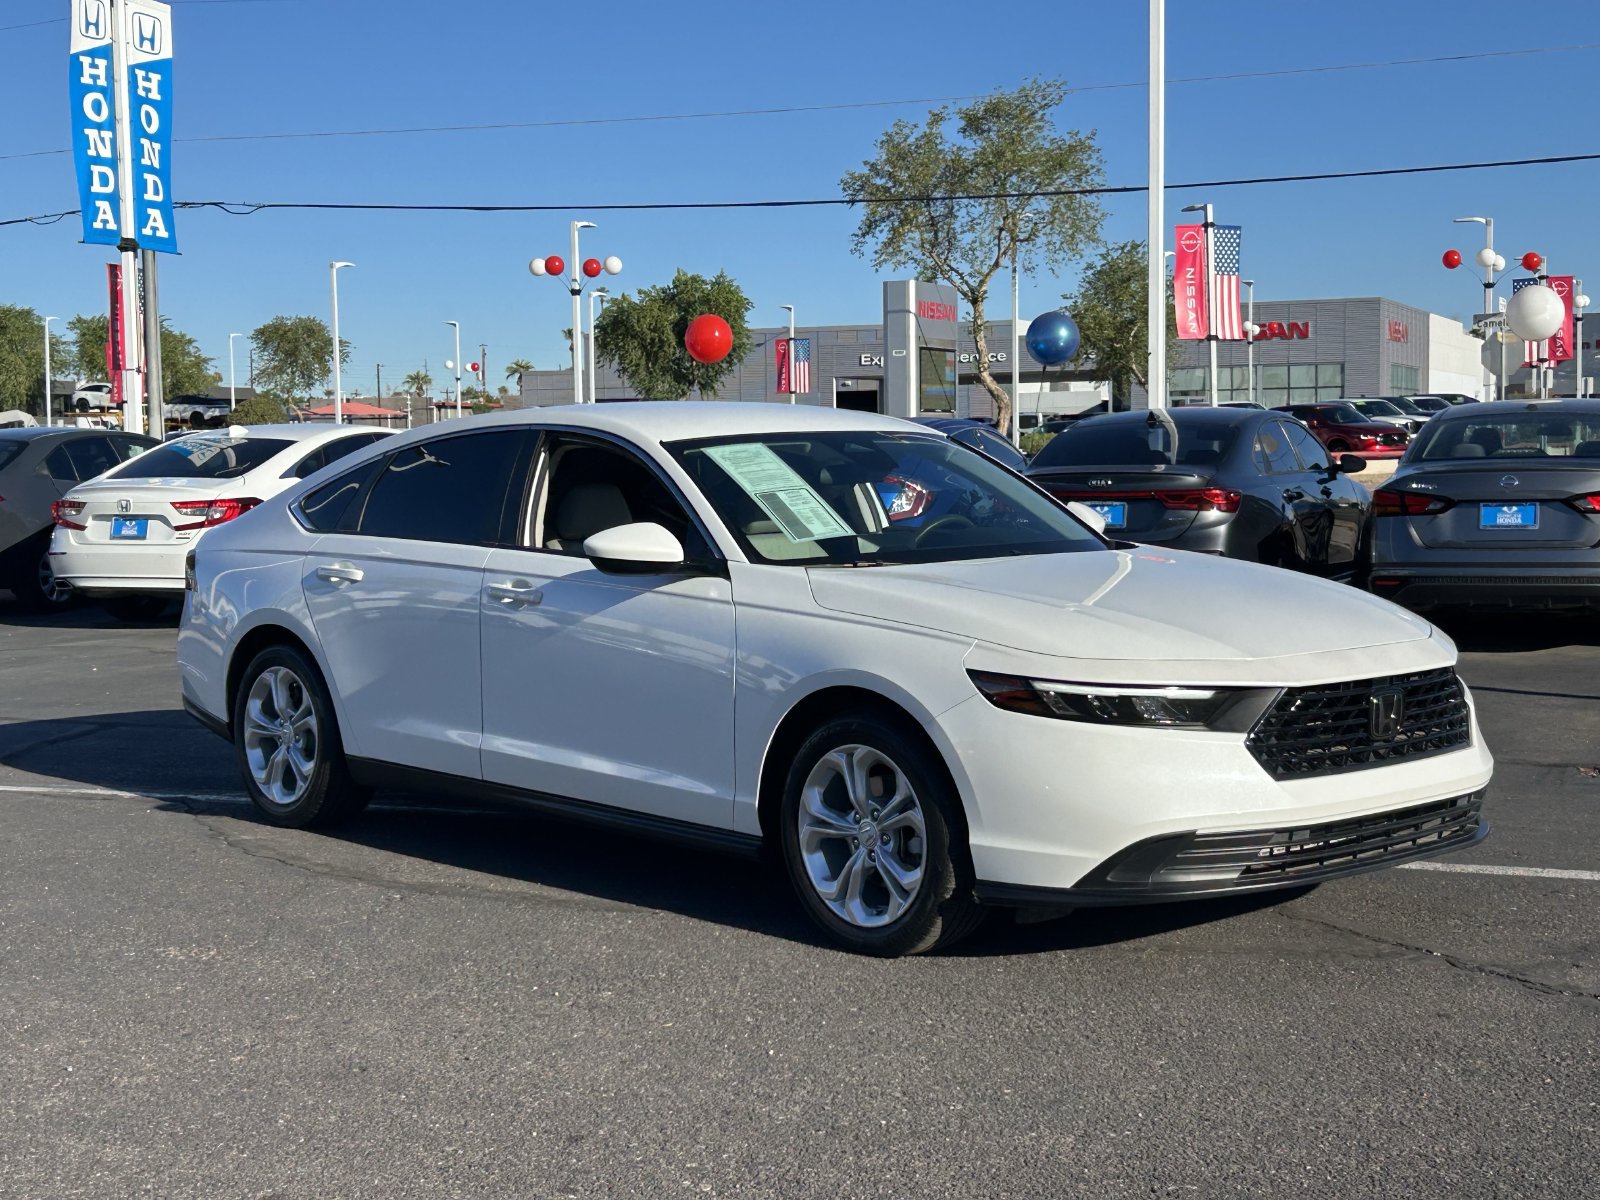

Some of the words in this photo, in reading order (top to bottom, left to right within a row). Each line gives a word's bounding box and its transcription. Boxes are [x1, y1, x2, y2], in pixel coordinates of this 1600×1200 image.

[79, 55, 118, 231] HONDA
[134, 68, 169, 239] HONDA
[917, 299, 957, 323] NISSAN
[1185, 267, 1199, 333] NISSAN
[1243, 320, 1310, 341] SAN
[1477, 318, 1509, 328] Camel
[1555, 329, 1564, 357] SAN
